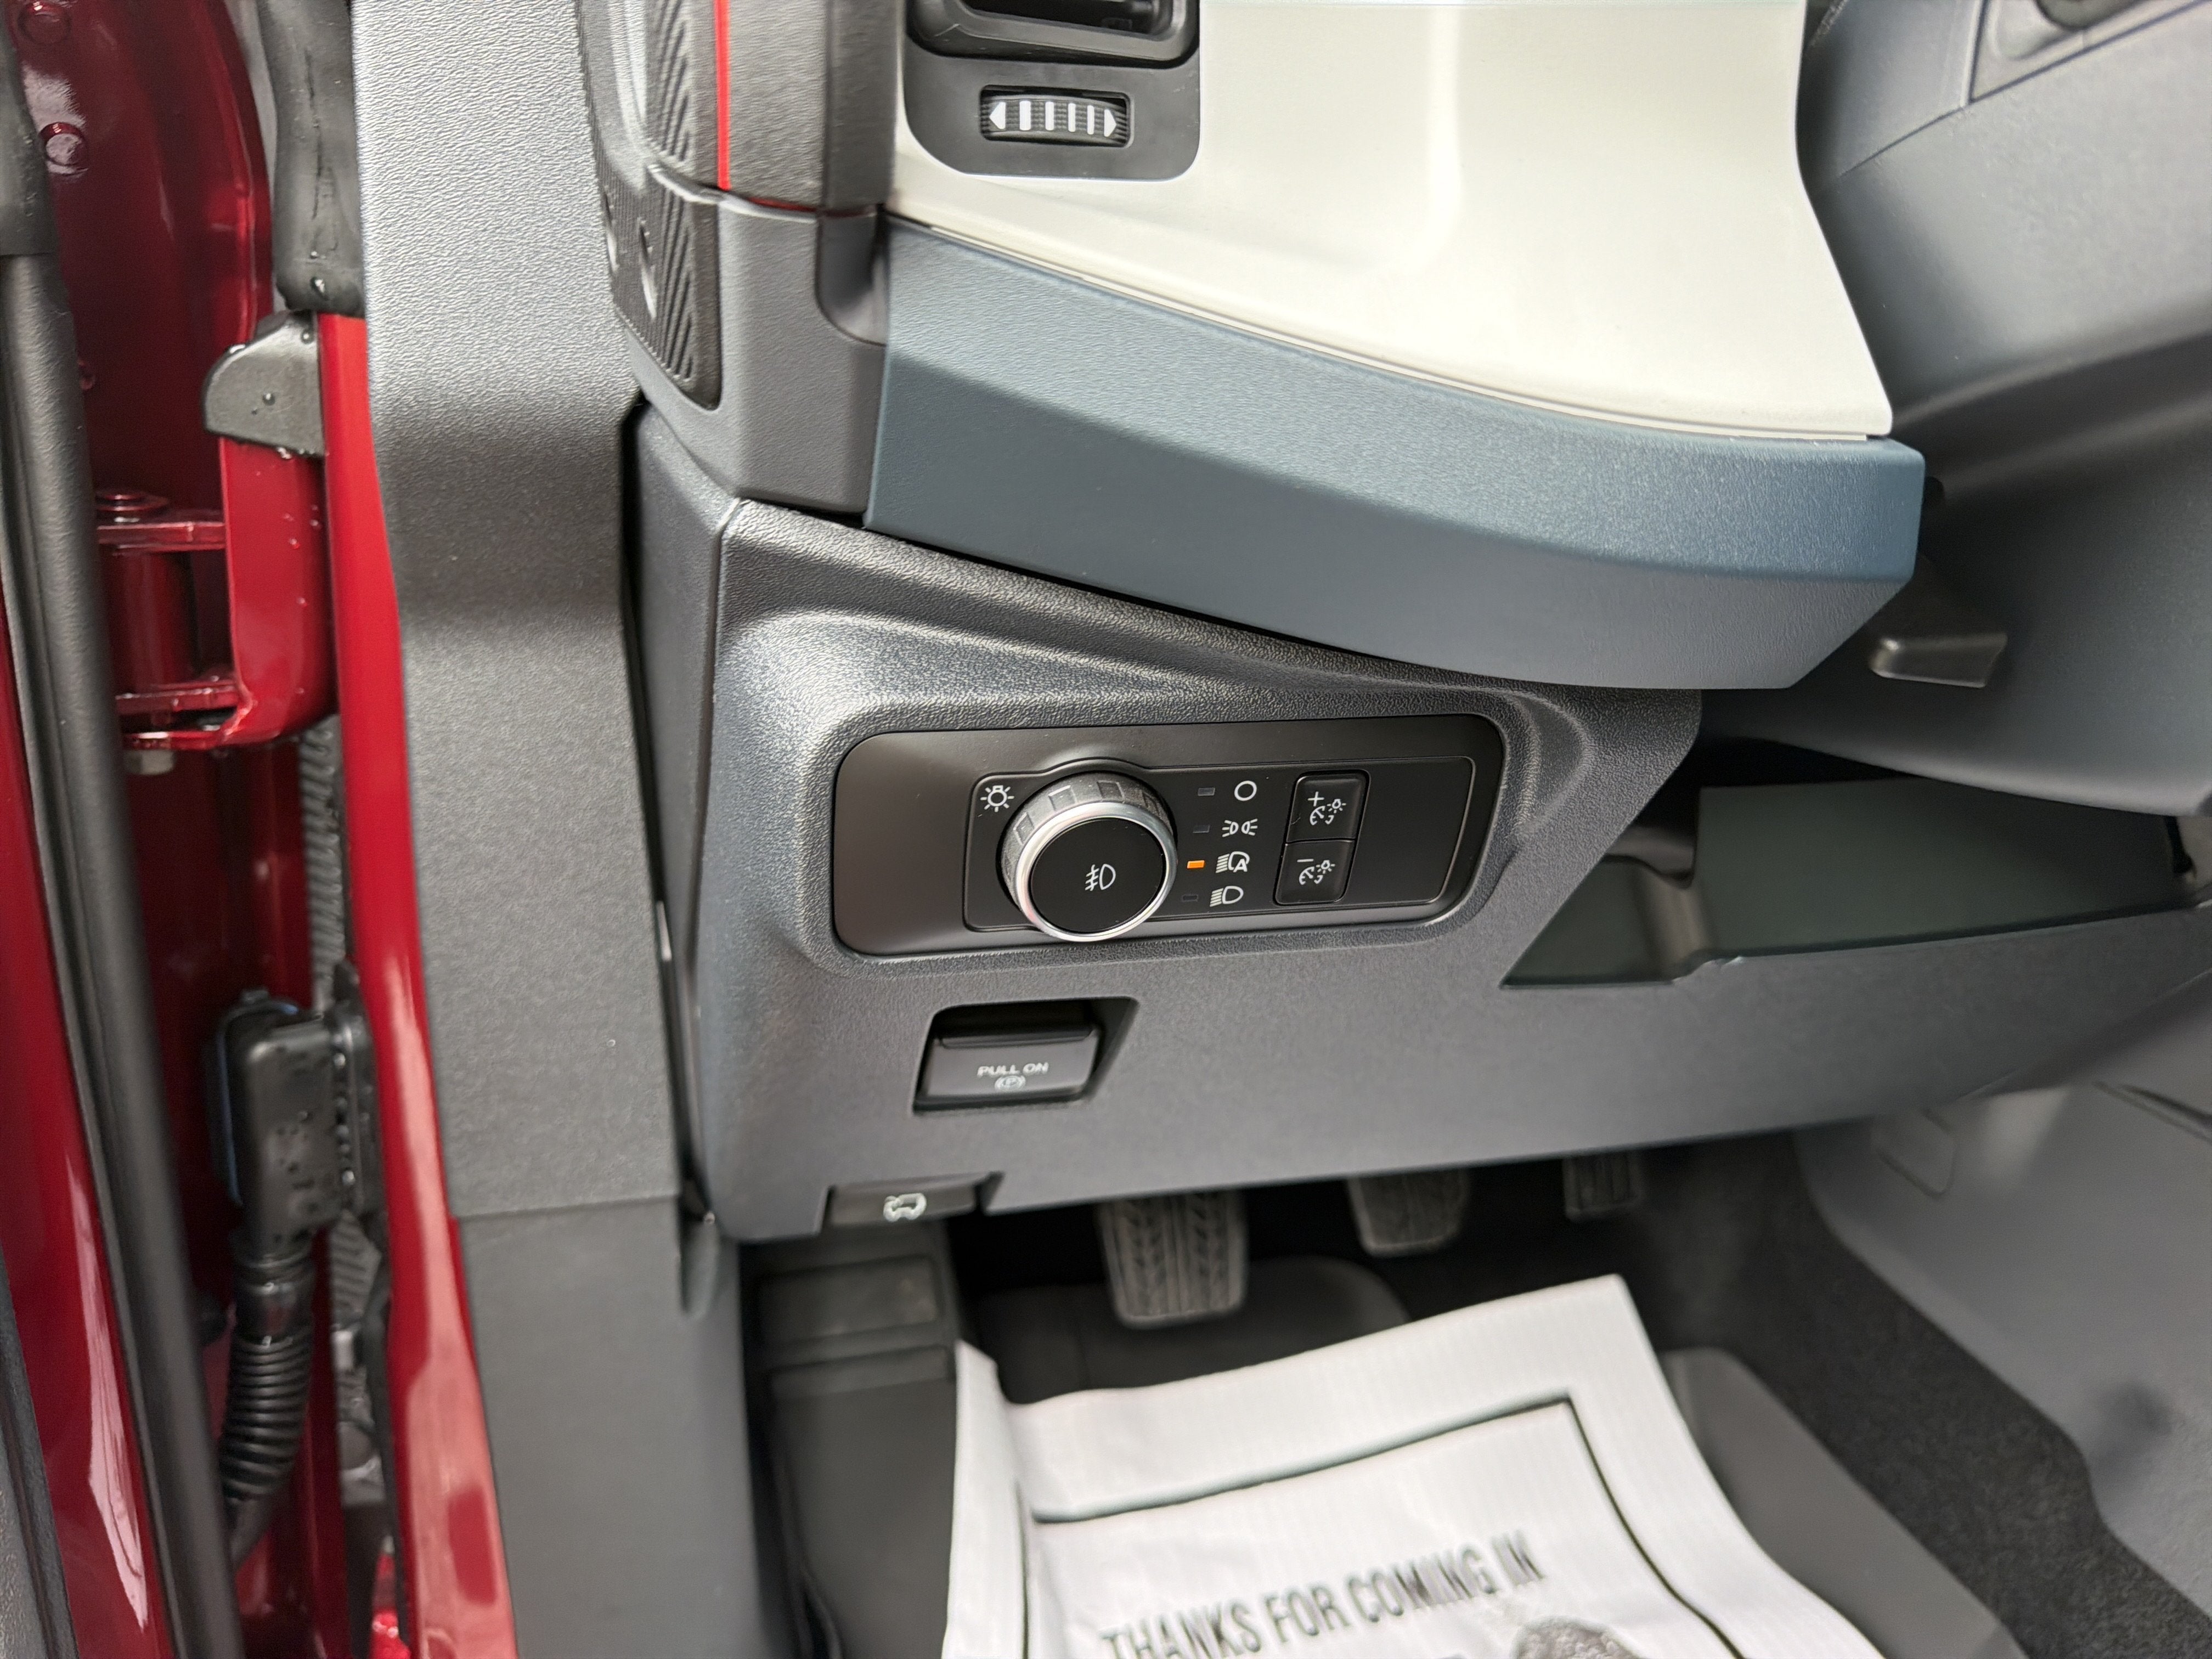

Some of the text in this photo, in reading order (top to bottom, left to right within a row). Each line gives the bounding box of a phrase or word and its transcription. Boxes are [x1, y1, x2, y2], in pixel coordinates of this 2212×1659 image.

[977, 1062, 1049, 1078] PULL ON
[1099, 1530, 1546, 1659] THANKS FOR COMING IN
